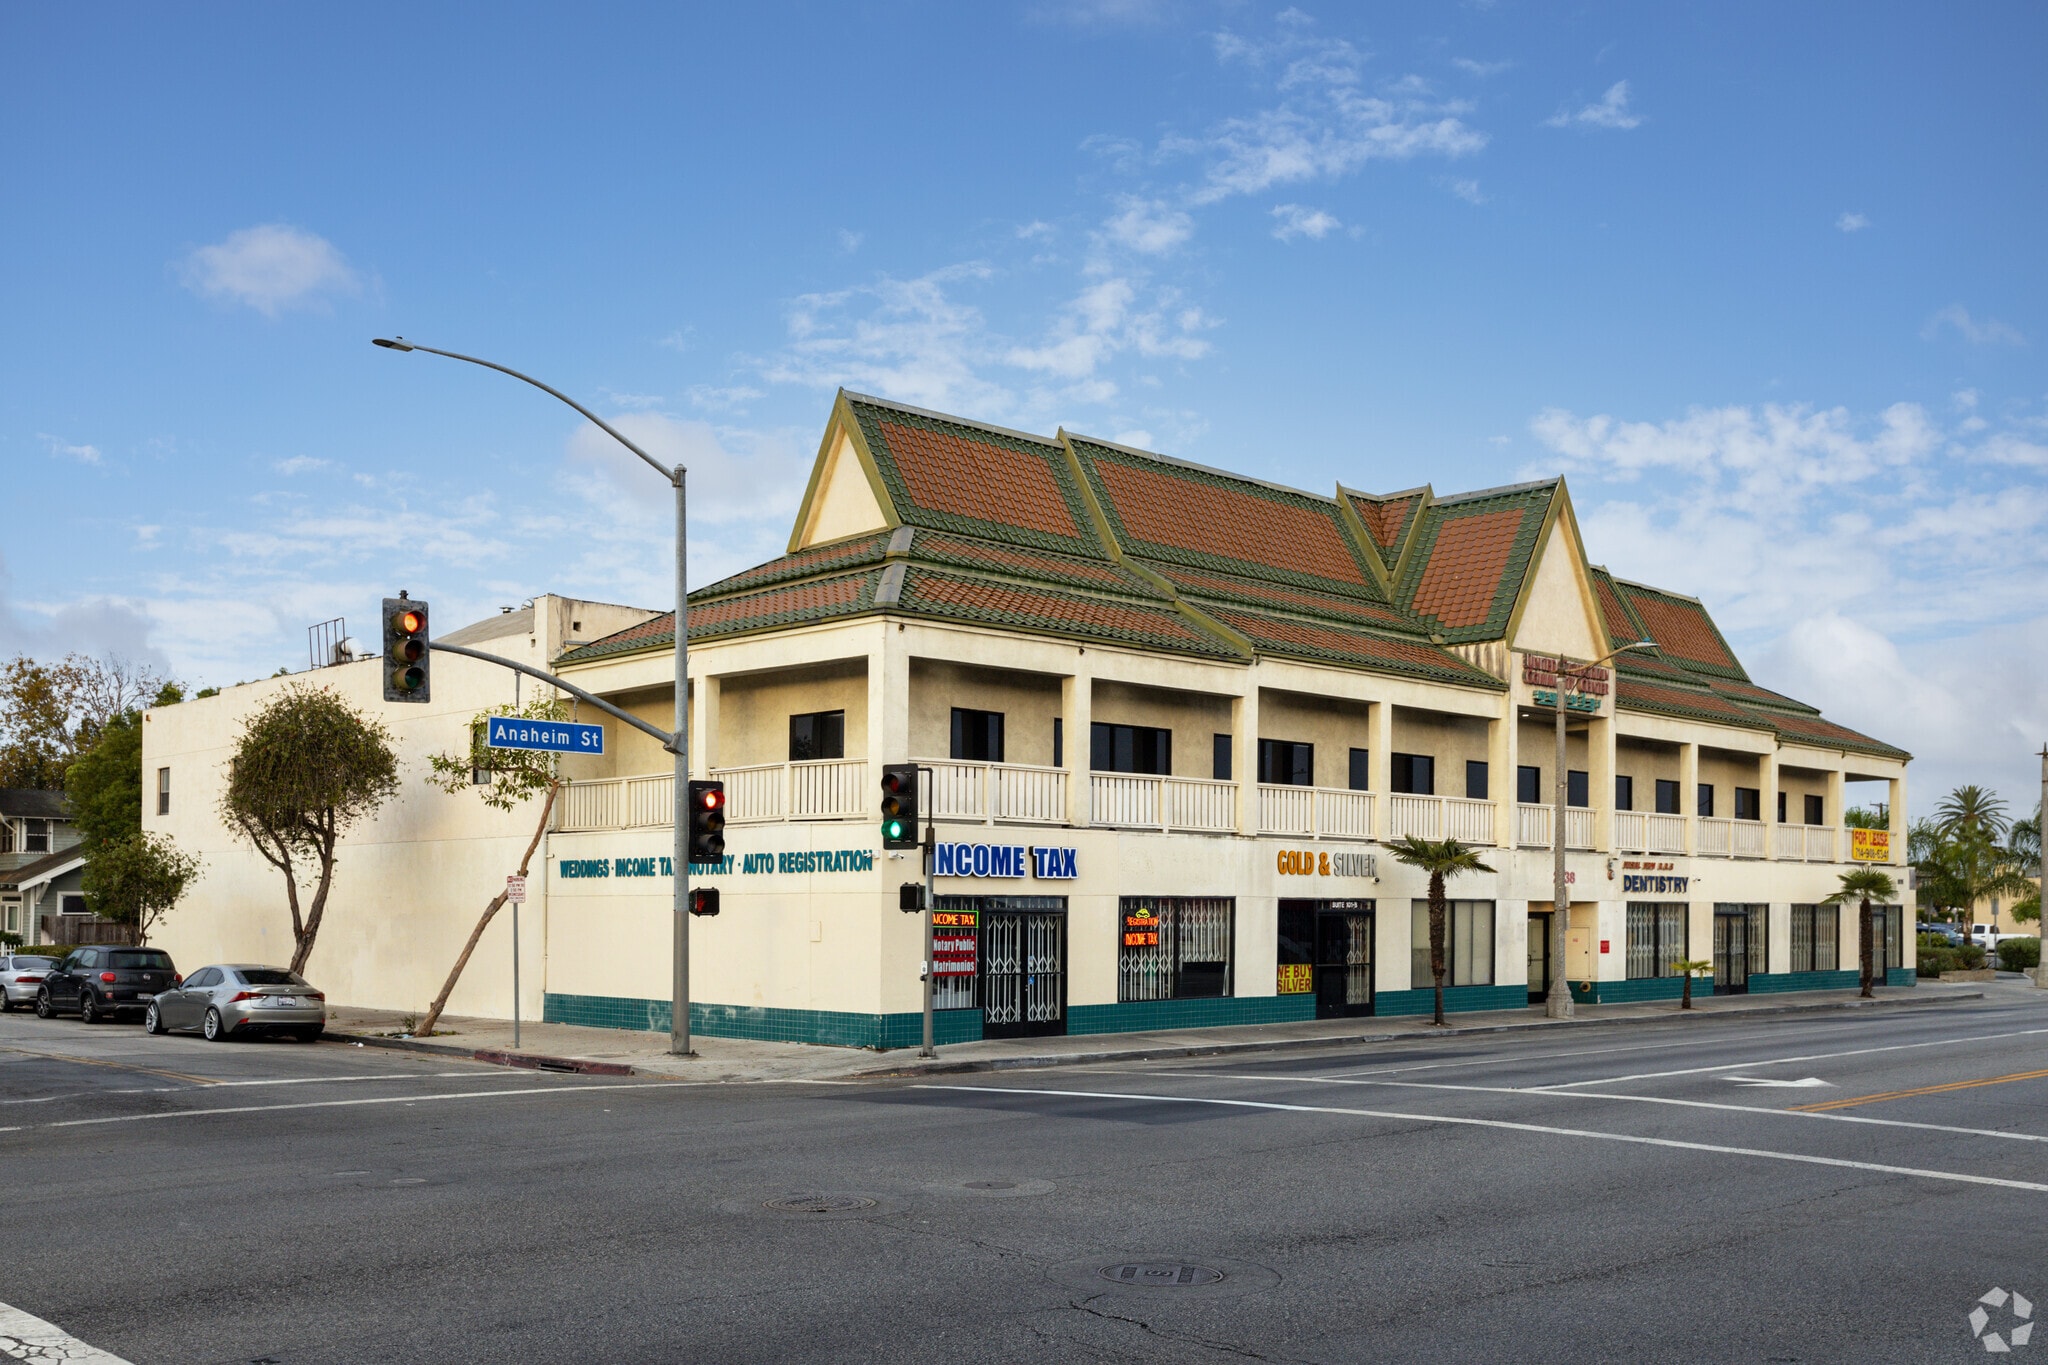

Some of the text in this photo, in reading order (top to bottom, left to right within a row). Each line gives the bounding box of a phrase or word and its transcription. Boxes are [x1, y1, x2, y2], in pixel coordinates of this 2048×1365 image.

[495, 725, 599, 747] Anaheim St
[560, 859, 609, 879] WEDDINGS
[615, 857, 656, 878] INCOME
[658, 857, 675, 876] TA
[742, 852, 775, 875] AUTO
[778, 849, 873, 874] REGISTRATION
[1032, 846, 1078, 879] TAX
[1277, 850, 1377, 878] GOLD & SILVER
[1623, 875, 1689, 893] DENTISTRY
[932, 913, 975, 925] NCOME TAX
[933, 939, 975, 952] Notary Public
[1147, 932, 1158, 945] TAX
[933, 960, 975, 973] Matrimonios
[1278, 965, 1312, 979] WE BUY
[1278, 978, 1311, 992] SILVER
